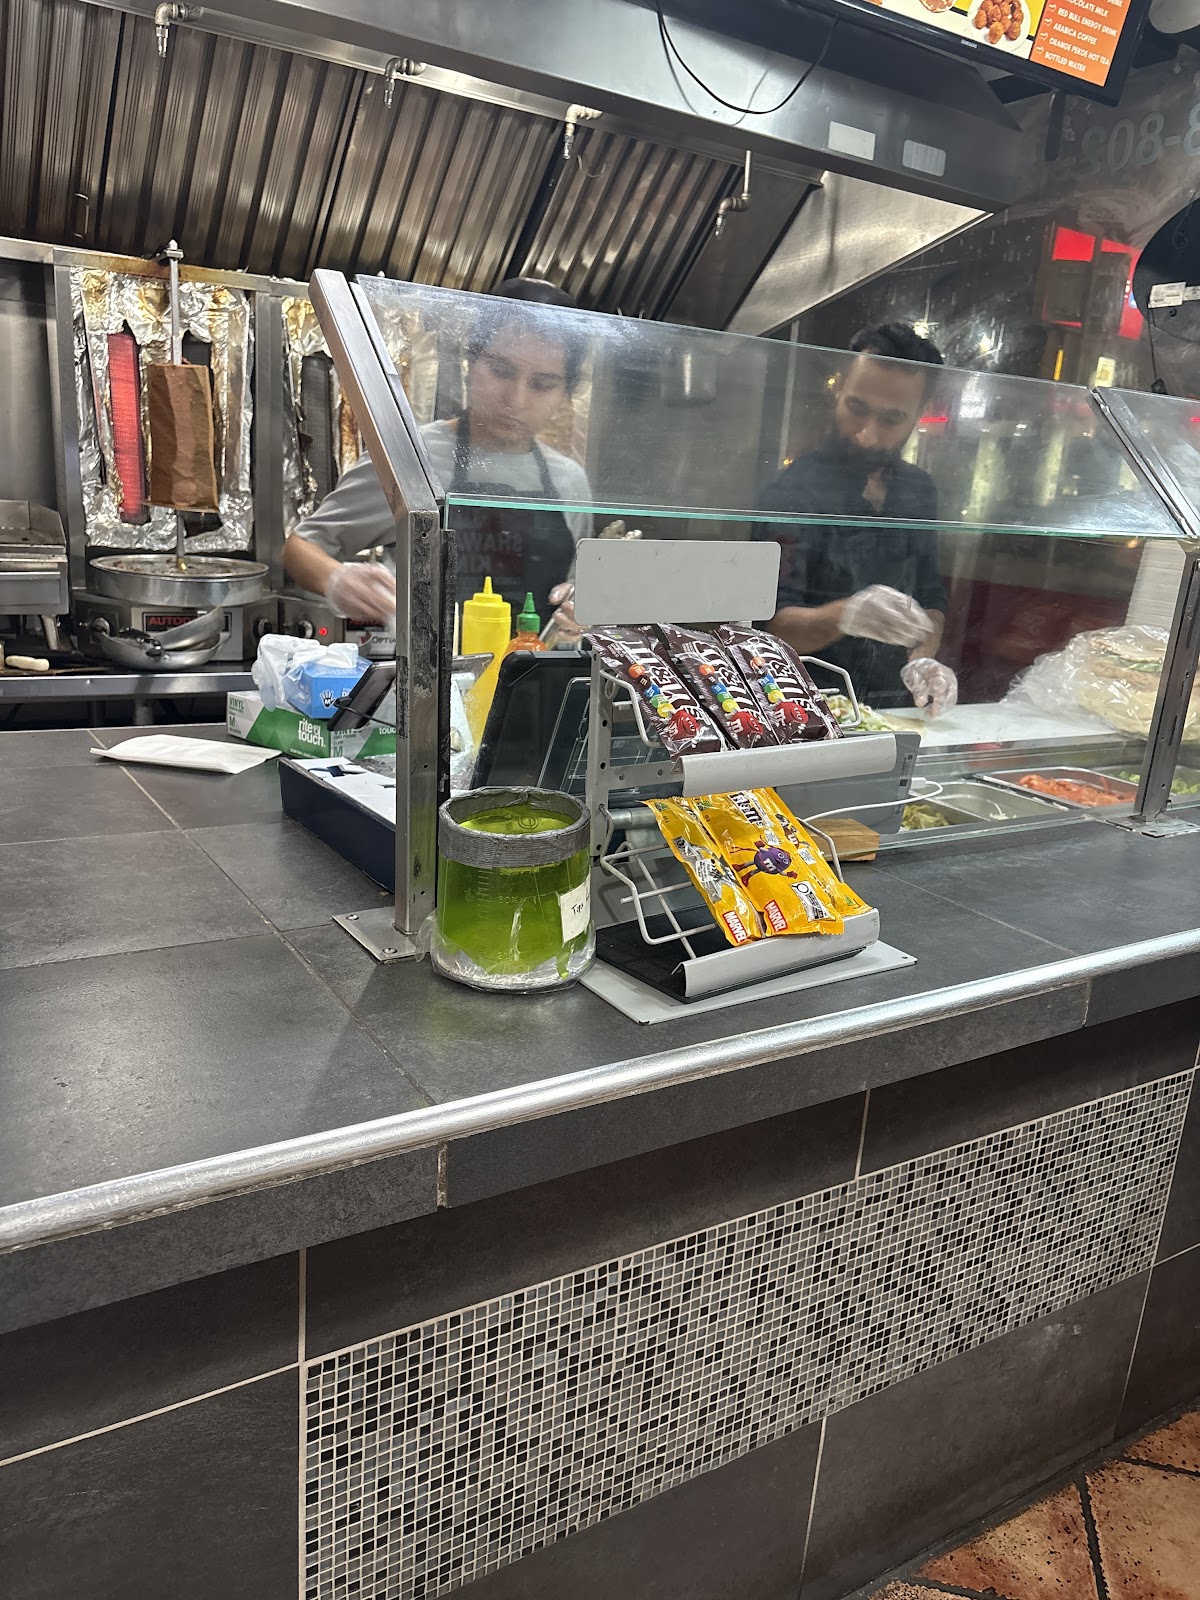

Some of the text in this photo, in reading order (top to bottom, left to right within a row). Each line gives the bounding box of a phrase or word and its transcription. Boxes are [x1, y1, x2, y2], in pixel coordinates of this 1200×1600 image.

[1067, 0, 1109, 17] OCOLATE MILK
[1057, 7, 1118, 37] RED BULL ENERGY DRINK
[1053, 23, 1098, 45] ARABICA COFFEE
[1049, 37, 1110, 65] ORANGE PEKOE HOT TEA
[1044, 51, 1087, 72] BOTTLED WATER
[229, 715, 236, 727] M
[298, 717, 313, 733] rite
[379, 726, 397, 735] touc
[333, 745, 343, 757] M
[763, 858, 777, 872] m
[764, 901, 786, 932] MARVEL
[723, 911, 746, 942] MARVEL
